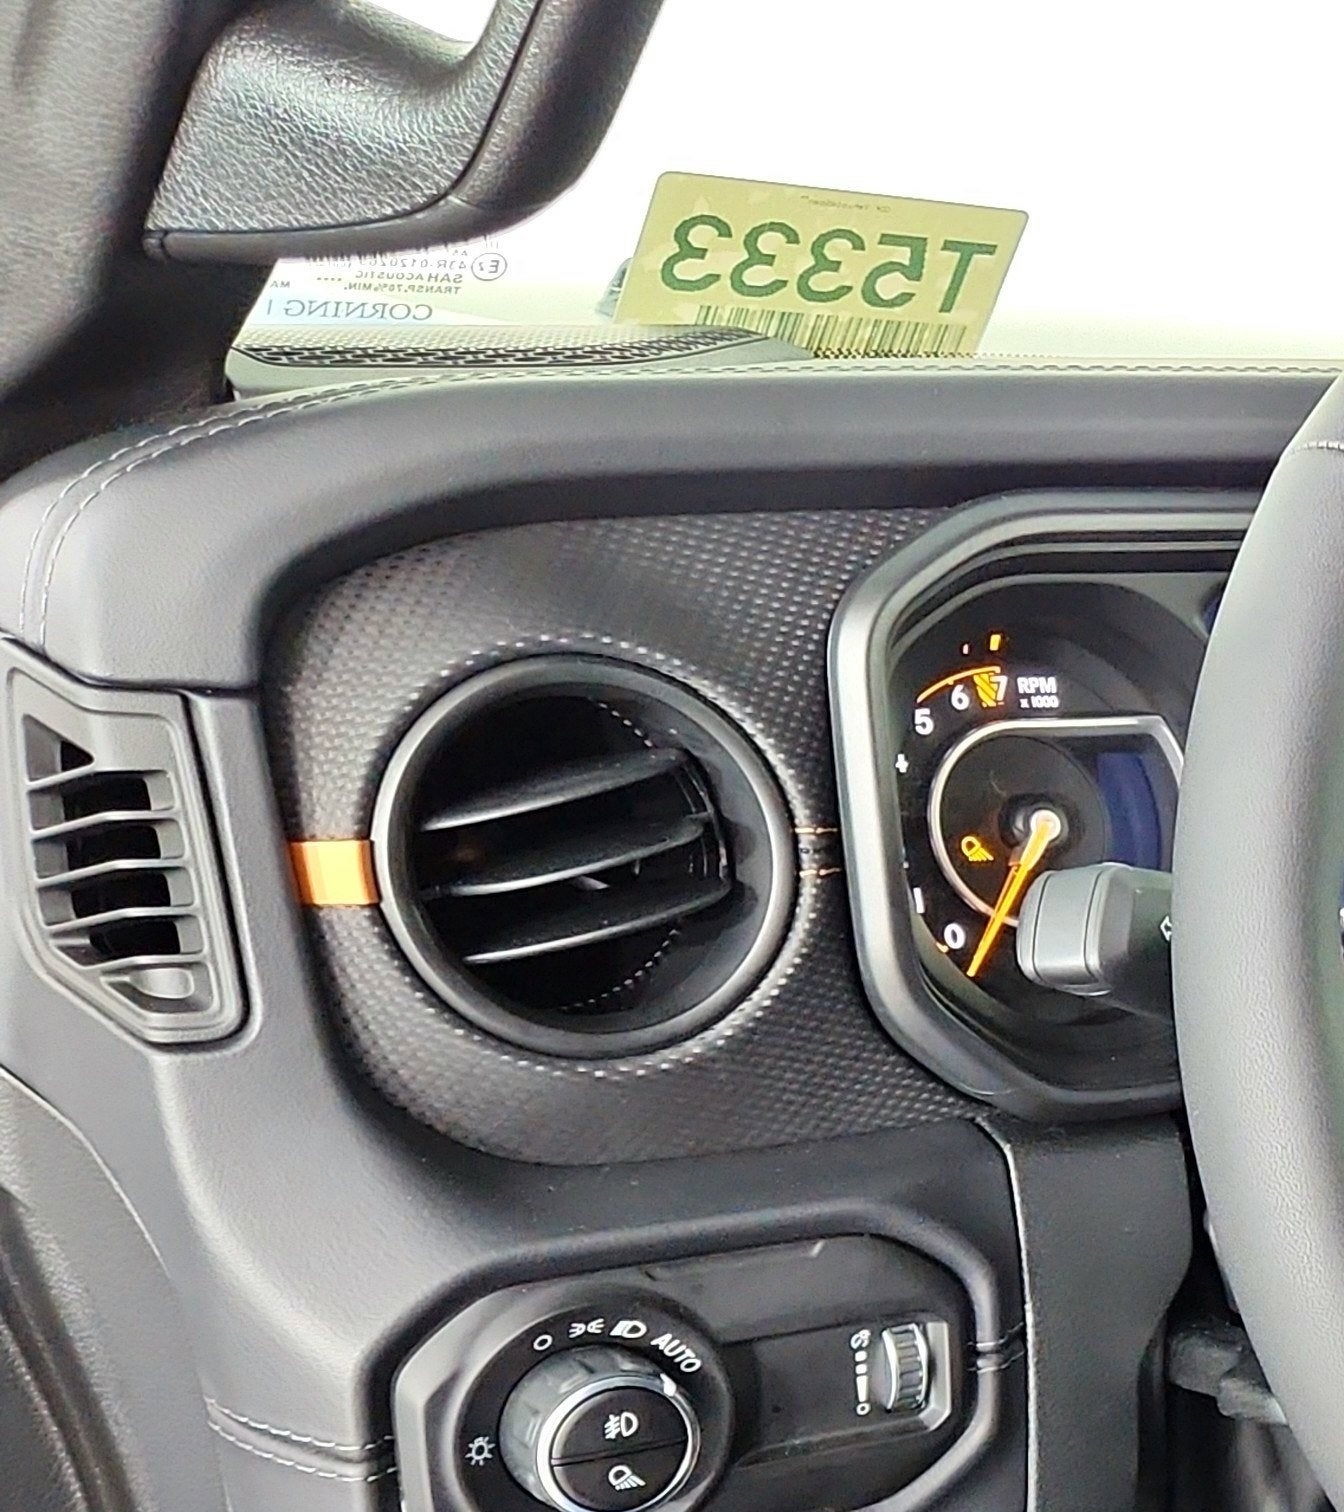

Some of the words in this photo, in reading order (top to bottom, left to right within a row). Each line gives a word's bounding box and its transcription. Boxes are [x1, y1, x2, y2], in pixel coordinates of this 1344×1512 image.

[950, 684, 970, 711] 6
[989, 675, 1008, 702] 7
[1017, 676, 1057, 694] RPM
[1031, 695, 1060, 709] 1000
[914, 707, 935, 736] 5
[943, 923, 966, 950] 0
[650, 1333, 703, 1373] AUTO
